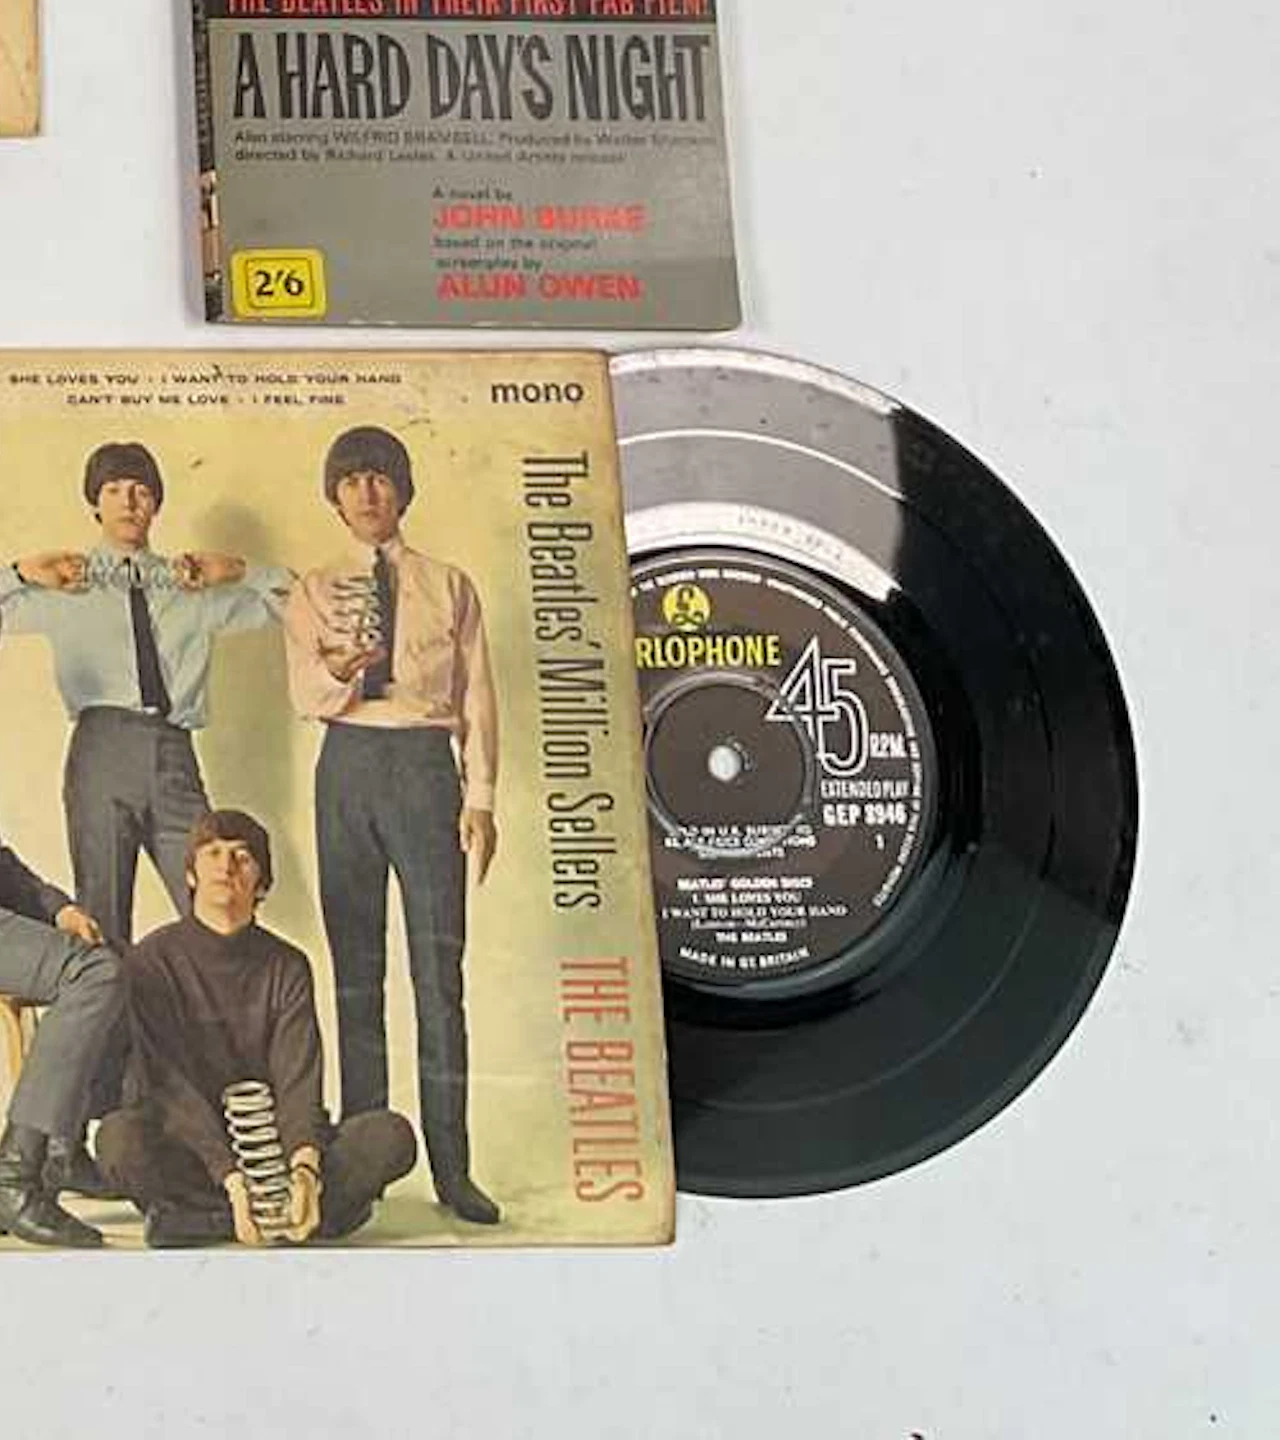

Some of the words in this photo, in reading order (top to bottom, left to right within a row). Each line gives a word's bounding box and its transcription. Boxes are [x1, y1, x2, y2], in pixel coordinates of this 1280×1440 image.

[233, 32, 266, 120] A
[276, 32, 410, 120] HARD
[427, 33, 553, 120] DAY'S
[565, 34, 711, 122] NIGHT
[436, 203, 523, 229] JOHN
[539, 272, 645, 300] OWEN
[9, 373, 40, 385] SHE
[46, 373, 99, 385] LOVES
[105, 373, 140, 385] YOU
[171, 373, 220, 385] WANT
[225, 374, 248, 385] TO
[255, 374, 299, 385] HOLD
[304, 374, 349, 385] YOUR
[355, 374, 403, 385] HAND
[121, 394, 153, 405] BUY
[188, 394, 229, 405] LOVE
[490, 380, 585, 403] mono
[522, 451, 591, 508] The
[537, 658, 610, 780] Million
[764, 635, 870, 776] 45
[870, 732, 907, 758] RPM
[823, 803, 861, 827] GEP
[545, 791, 617, 910] Sellers
[559, 956, 631, 1025] THE
[564, 1038, 644, 1203] BEATLES
